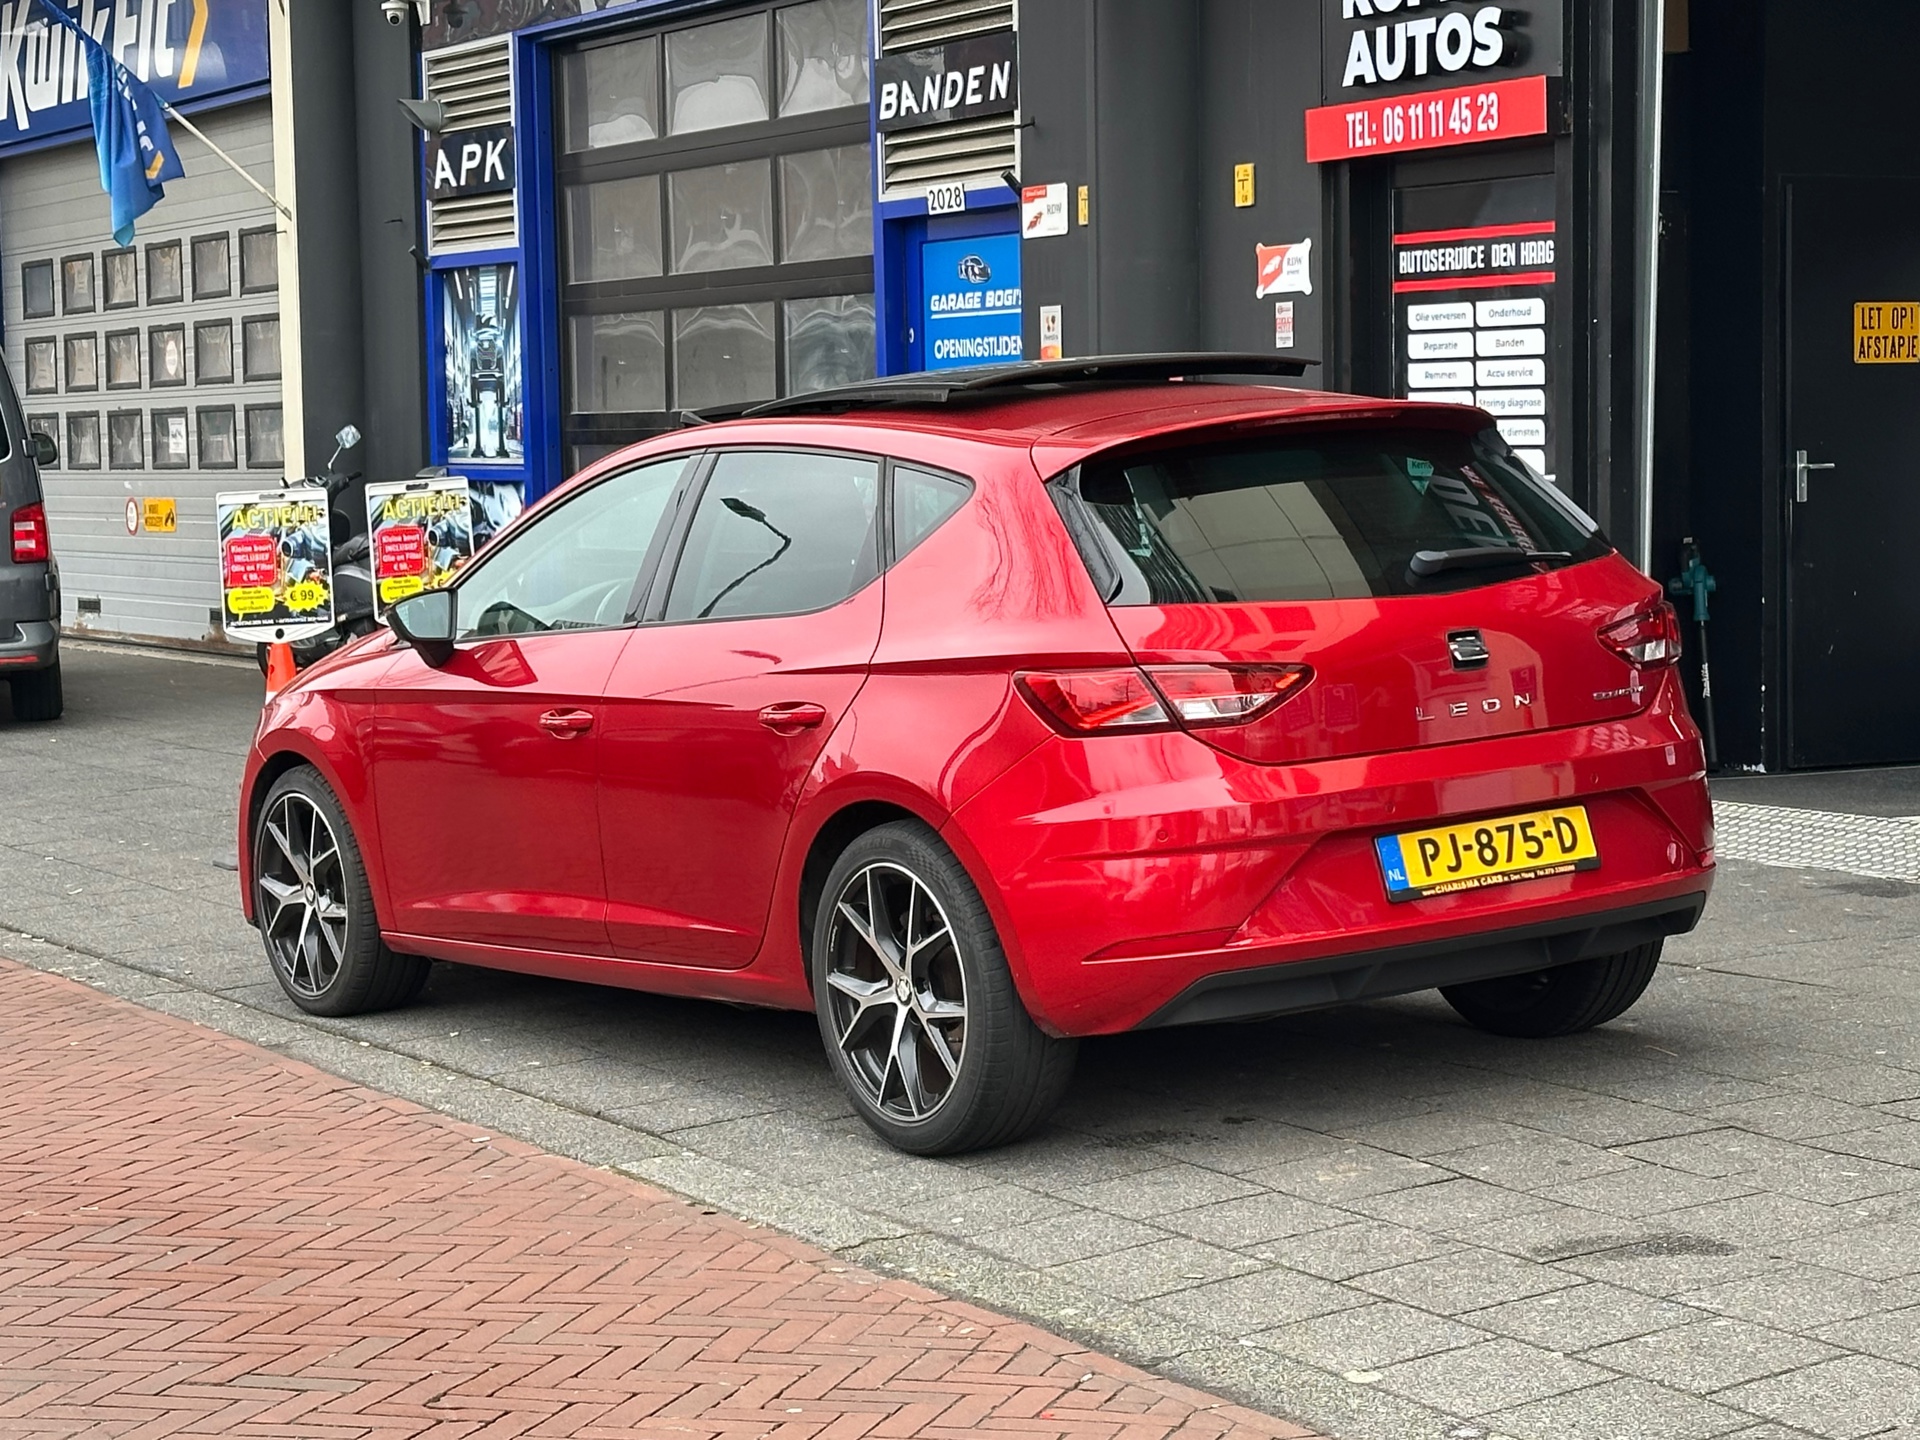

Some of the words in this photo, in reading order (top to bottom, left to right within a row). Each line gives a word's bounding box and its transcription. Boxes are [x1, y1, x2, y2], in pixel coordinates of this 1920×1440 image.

[1342, 7, 1503, 87] AUTOS
[879, 60, 1011, 120] BANDEN
[1345, 110, 1377, 149] TEL:
[1383, 106, 1404, 145] 06
[1408, 103, 1424, 141] 11
[1428, 100, 1444, 138] 11
[1449, 96, 1472, 135] 45
[1477, 92, 1499, 132] 23
[434, 138, 507, 189] APK
[928, 187, 963, 212] 2028
[1399, 245, 1485, 274] AUTOSERVICE
[1491, 242, 1516, 268] DEN
[1520, 240, 1555, 265] HAAG
[930, 291, 982, 312] GARAGE
[1415, 312, 1429, 322] Olie
[1431, 312, 1466, 321] verversen
[1488, 307, 1531, 319] Onderhoud
[1861, 307, 1882, 330] LET
[1423, 340, 1458, 352] Reparatie
[1495, 339, 1524, 348] Banden
[1858, 335, 1918, 359] AFSTAPJE
[1424, 371, 1457, 380] Remmen
[1486, 369, 1505, 378] Accu
[1506, 367, 1533, 377] service
[1479, 398, 1505, 409] Storing
[1507, 397, 1542, 409] diagnose
[1507, 427, 1540, 437] diensten
[1415, 693, 1532, 721] LEON
[1417, 816, 1578, 877] PJ-875-D
[1388, 868, 1405, 882] NL
